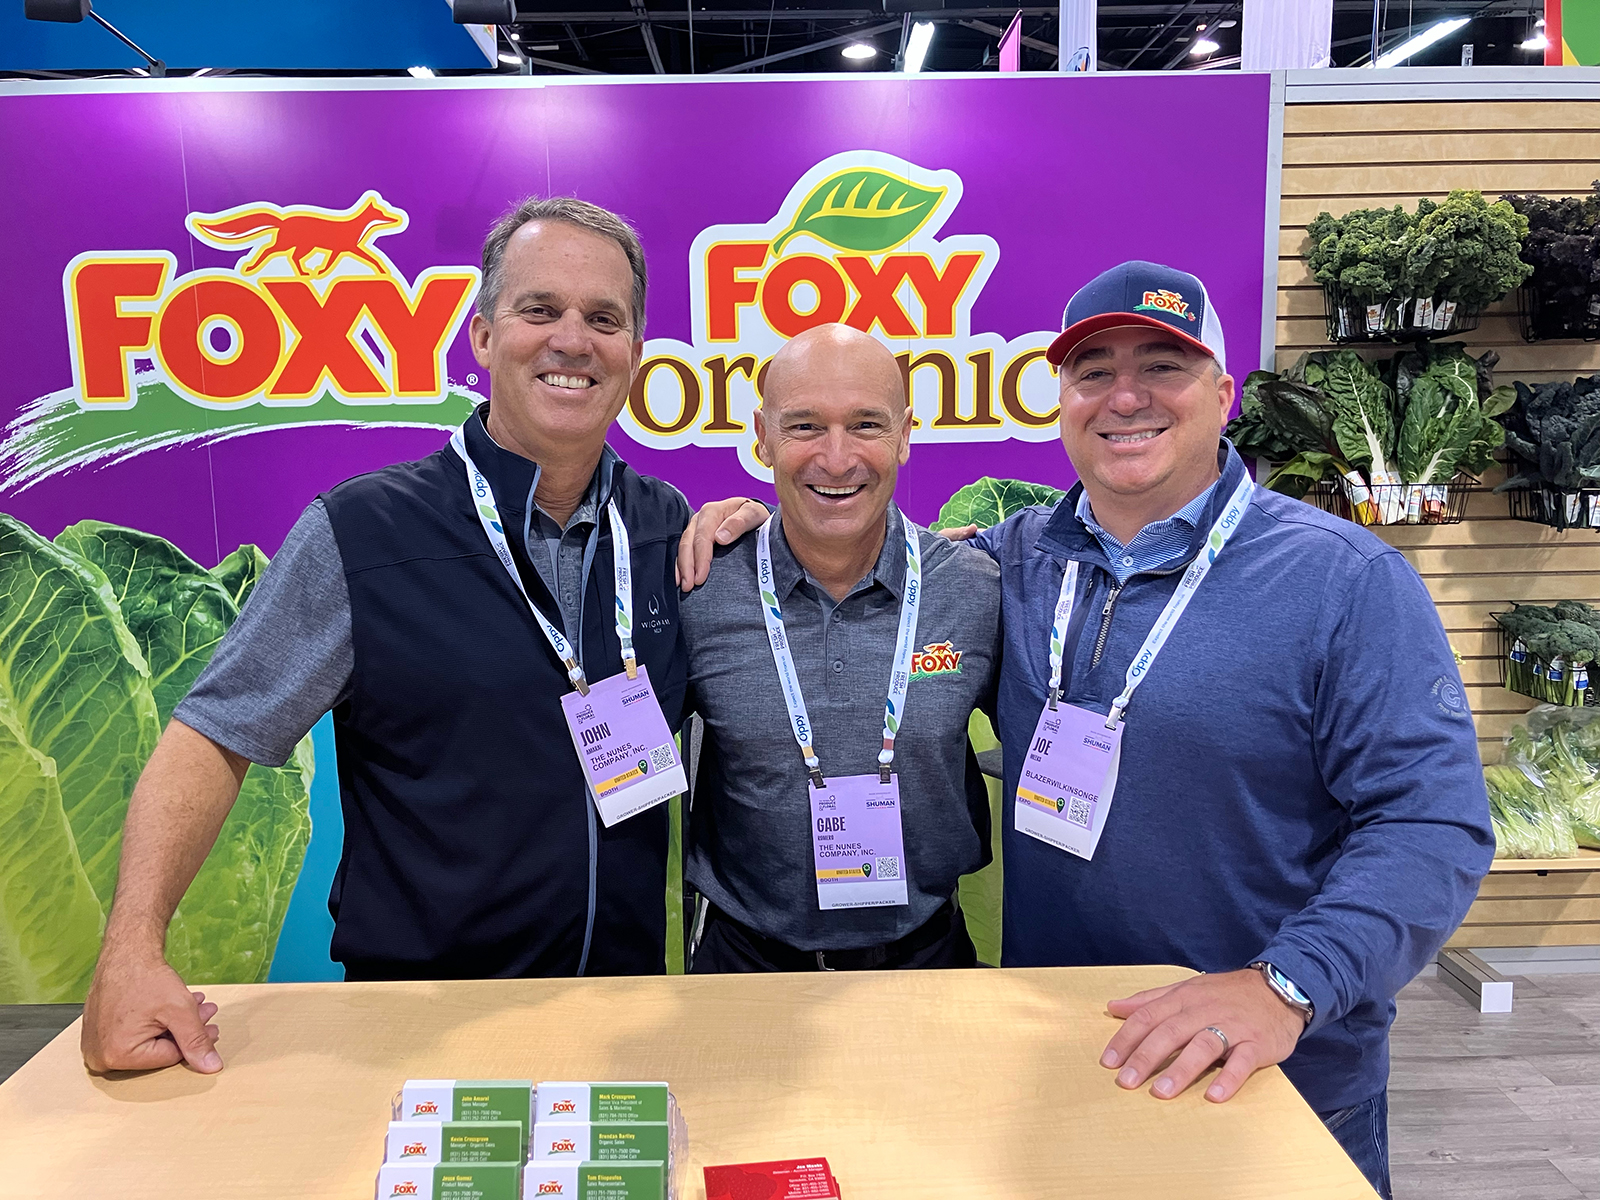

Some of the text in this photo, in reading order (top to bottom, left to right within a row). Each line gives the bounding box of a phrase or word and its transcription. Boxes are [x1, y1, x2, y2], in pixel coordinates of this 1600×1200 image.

[705, 241, 985, 342] FOXY
[1144, 292, 1188, 314] FOXY
[74, 258, 477, 402] FOXY
[628, 347, 1060, 468] ornic
[473, 470, 486, 498] Oppy
[1220, 505, 1240, 529] Oppy
[760, 558, 769, 584] Oppy
[1182, 570, 1198, 588] FRESH
[906, 579, 919, 607] Oppy
[546, 624, 565, 653] Oppy
[772, 633, 781, 650] FRESH
[775, 626, 786, 649] PRODUCE
[910, 652, 962, 674] FOXY
[1131, 649, 1152, 677] Oppy
[892, 670, 901, 695] PRODUCE
[898, 671, 907, 689] FRESH
[622, 690, 650, 705] SHUMAN
[580, 722, 611, 747] JOHN
[794, 714, 809, 742] Oppy
[590, 743, 632, 765] THE NUNES
[1033, 737, 1052, 755] JOE
[1083, 738, 1111, 751] SHUMAN
[592, 745, 648, 772] COMPANY, INC.
[600, 786, 619, 798] BOOTH
[1026, 770, 1098, 802] BLAZERWILKINSONGE
[1018, 797, 1031, 805] EXPO
[817, 817, 846, 832] GABE
[415, 1104, 438, 1113] FOXY
[553, 1103, 576, 1112] FOXY
[404, 1146, 427, 1154] FOXY
[552, 1142, 575, 1151] FOXY
[394, 1185, 418, 1193] FOXY
[539, 1184, 563, 1193] FOXY
